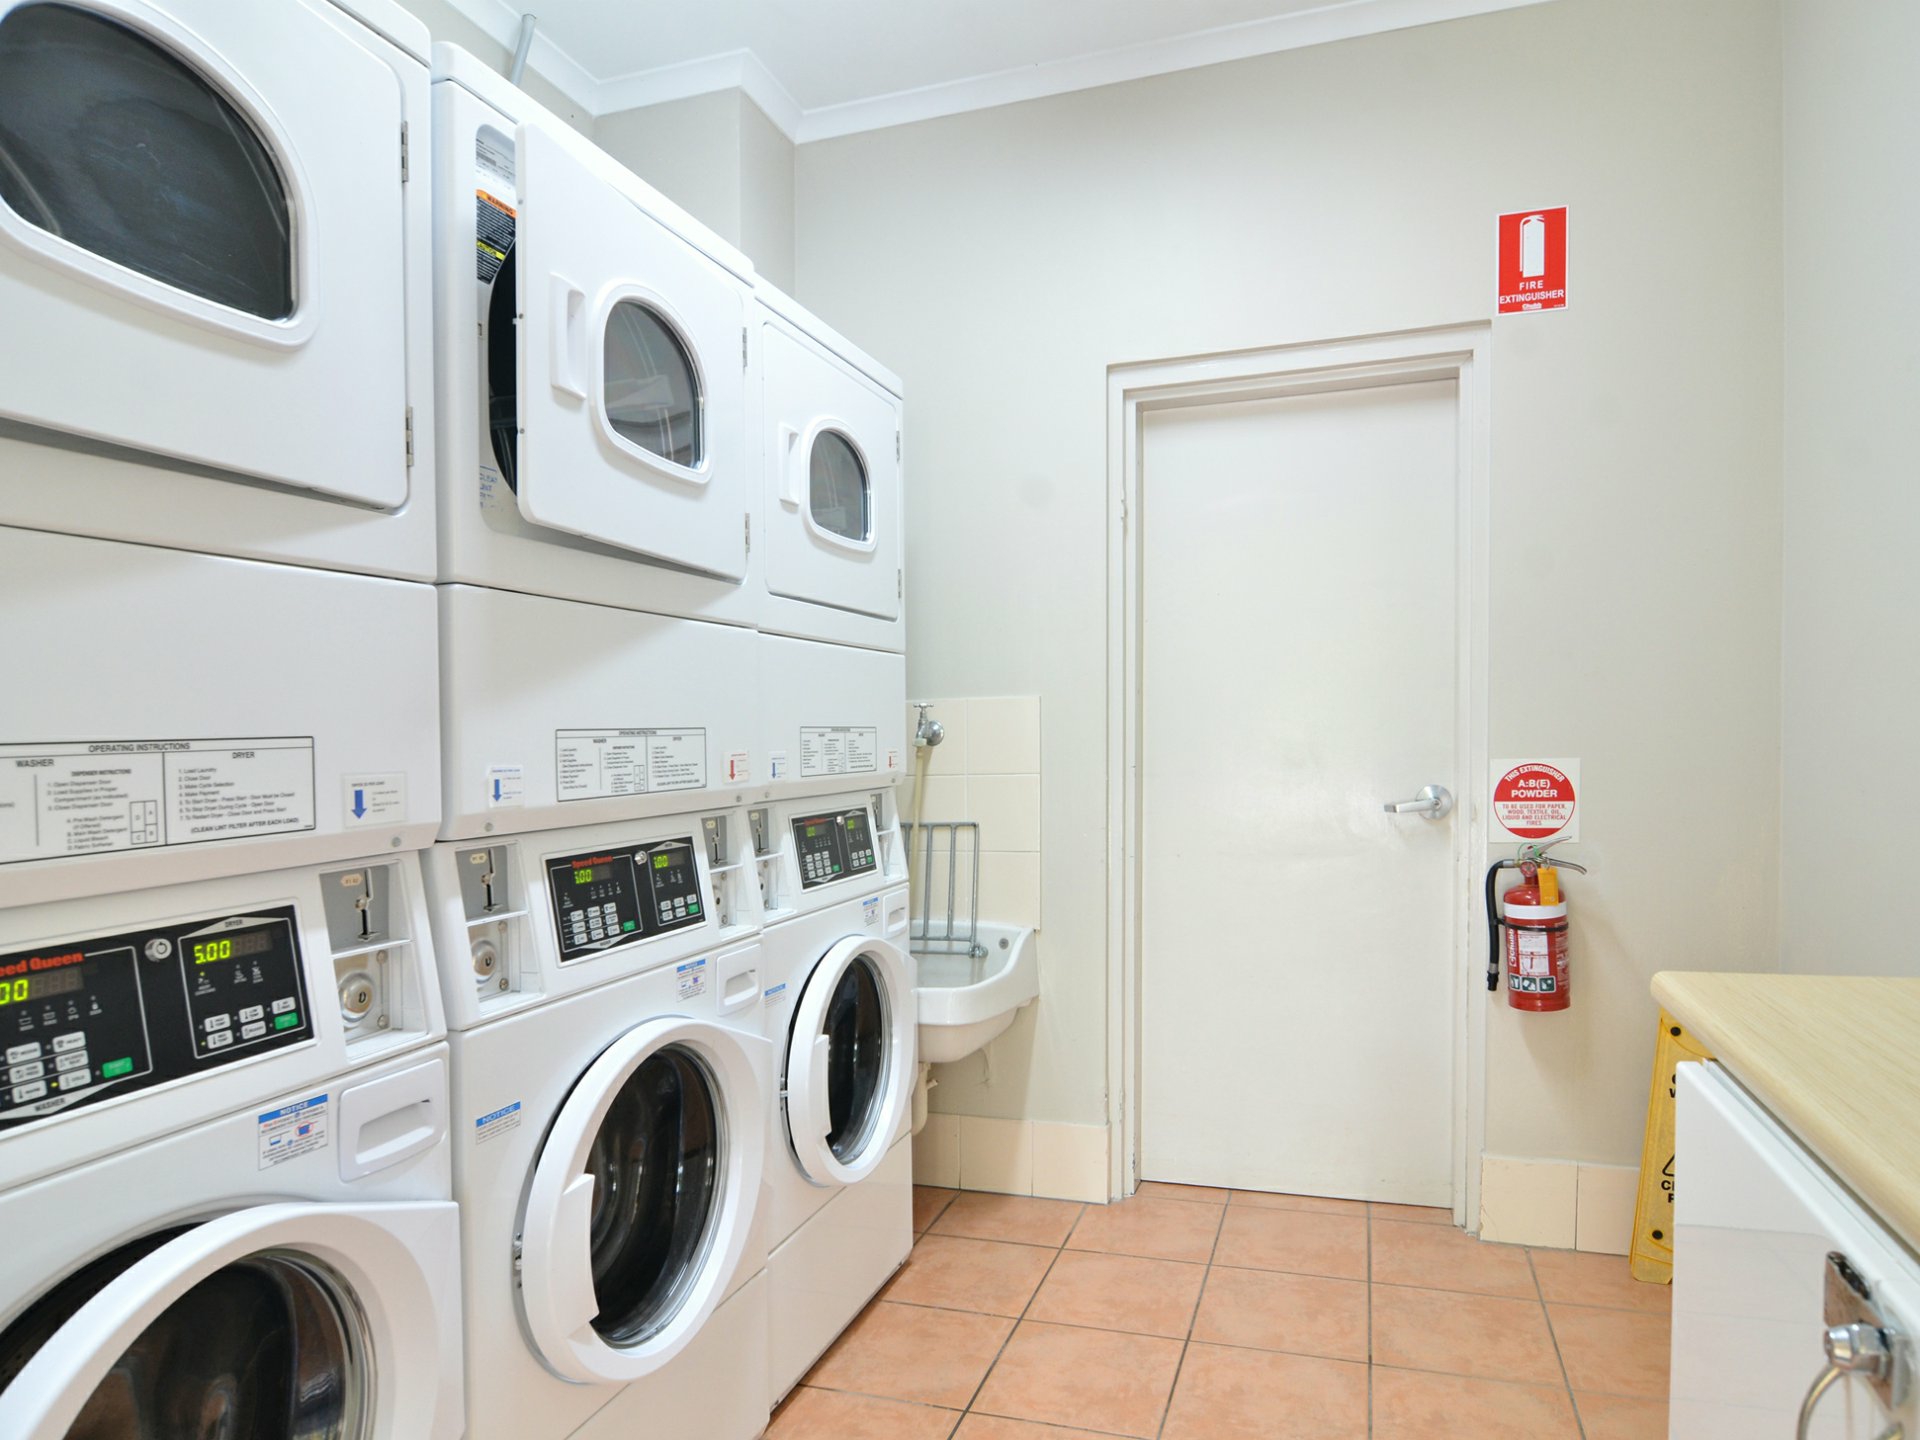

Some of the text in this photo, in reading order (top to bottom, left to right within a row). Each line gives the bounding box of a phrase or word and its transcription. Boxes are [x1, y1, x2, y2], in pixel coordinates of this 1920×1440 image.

[1519, 280, 1544, 291] FIRE
[1499, 289, 1564, 304] EXTINGUISHER
[88, 742, 190, 753] OPERATING INSTRUCTIONS
[15, 758, 55, 768] WASHER
[1504, 765, 1566, 782] THIS EXTINGUISHER
[1518, 778, 1551, 789] A:B(E)
[1511, 789, 1558, 798] POWDER
[572, 858, 592, 869] Speed
[224, 919, 243, 928] DRYER
[194, 940, 231, 964] 5.00
[30, 952, 84, 971] Queen
[34, 1098, 66, 1112] WASHER
[280, 1101, 308, 1116] NOTICE
[482, 1105, 514, 1122] NOTICE
